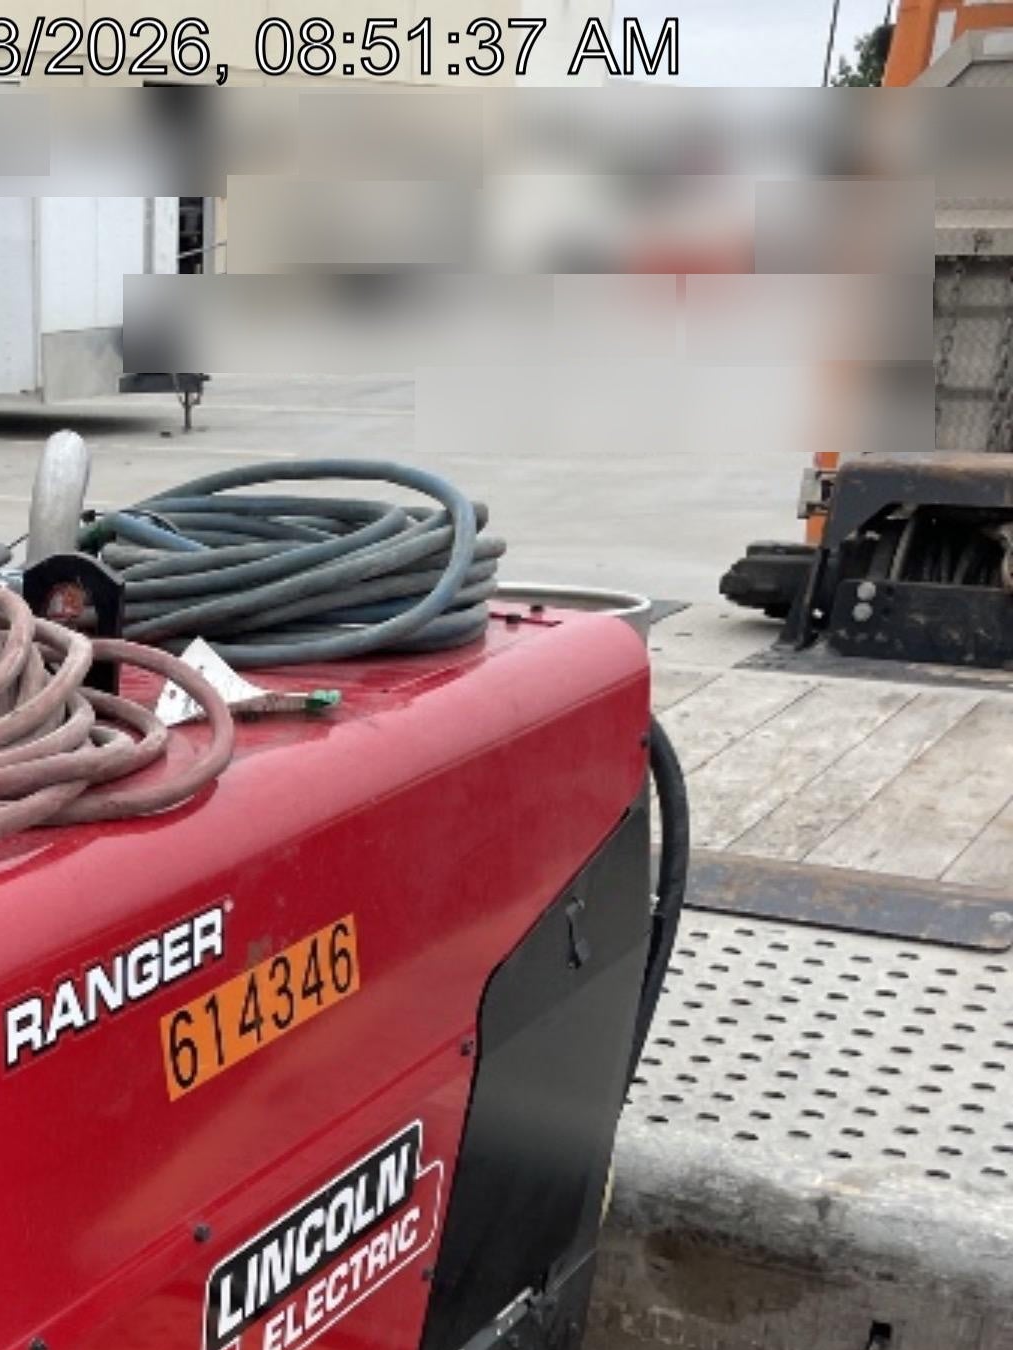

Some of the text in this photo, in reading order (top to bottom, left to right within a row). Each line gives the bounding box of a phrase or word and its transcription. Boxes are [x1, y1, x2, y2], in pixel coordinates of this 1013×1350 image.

[4, 907, 226, 1068] RANGER
[169, 921, 354, 1090] 614346
[217, 1143, 412, 1339] LINCOLN
